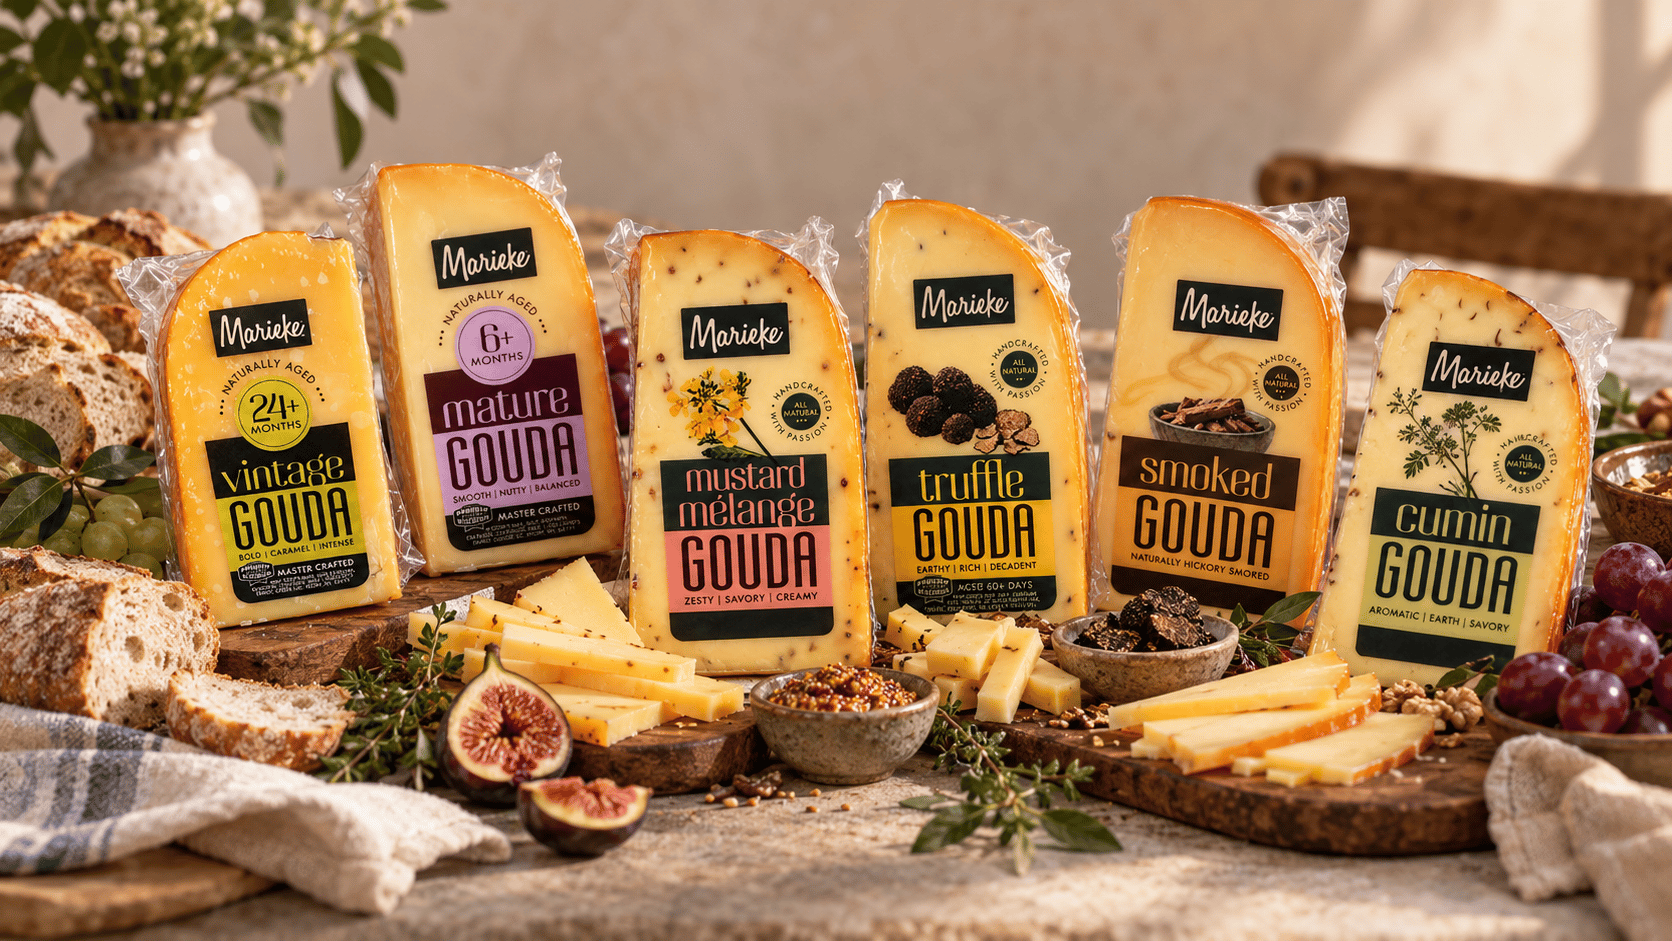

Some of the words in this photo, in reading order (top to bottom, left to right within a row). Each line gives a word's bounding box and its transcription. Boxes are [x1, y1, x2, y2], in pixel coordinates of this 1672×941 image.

[442, 243, 531, 281] Marieke
[443, 290, 504, 326] NATURALLY
[507, 293, 538, 316] AGED
[921, 285, 1010, 324] Marieke
[1180, 287, 1275, 333] Marieke
[220, 314, 306, 350] Marieke
[480, 323, 514, 353] 6+
[690, 314, 784, 353] Marieke
[471, 351, 524, 366] MONTHS
[1012, 358, 1025, 366] ALL
[1431, 349, 1526, 391] Marieke
[222, 359, 281, 395] NATURALLY
[285, 362, 316, 384] AGED
[990, 369, 1004, 393] WITH
[1007, 378, 1046, 399] PASSION
[1274, 373, 1289, 381] ALL
[250, 393, 299, 423] 24+
[443, 387, 569, 429] mature
[773, 381, 832, 412] HANDCRAFTED
[794, 401, 807, 409] ALL
[250, 420, 302, 434] MONTHS
[770, 411, 786, 435] WITH
[786, 421, 827, 442] PASSION
[221, 453, 344, 492] vintage
[446, 422, 578, 491] GOUDA
[1519, 453, 1532, 461] ALL
[686, 456, 806, 493] mustard
[918, 459, 1024, 502] truffle
[1140, 455, 1273, 500] smoked
[1506, 476, 1550, 494] PASSION
[453, 491, 491, 504] SMOOTH
[500, 486, 527, 497] NUTTY
[535, 479, 581, 492] BALANCED
[229, 487, 353, 550] GOUDA
[497, 509, 536, 522] MASTER
[538, 502, 581, 515] CRAFTED
[679, 492, 815, 528] mélange
[1395, 503, 1512, 546] cumin
[270, 545, 310, 557] CARAMEL
[319, 538, 354, 550] INTENSE
[913, 503, 1036, 562] GOUDA
[1133, 494, 1275, 569] GOUDA
[315, 558, 354, 571] CRAFTED
[681, 531, 818, 592] GOUDA
[917, 565, 950, 574] EARTHY
[959, 564, 980, 572] RICH
[990, 561, 1037, 571] DECADENT
[1130, 552, 1181, 567] NATURALLY
[1184, 560, 1226, 574] HICKORY
[1375, 541, 1518, 615] GOUDA
[684, 596, 714, 606] ZESTY
[725, 594, 765, 604] SAVORY
[776, 592, 818, 602] CREAMY
[1008, 580, 1033, 590] DAYS
[1369, 606, 1420, 621] AROMATIC
[1429, 614, 1460, 626] EARTH
[1469, 619, 1510, 633] SAVORY
